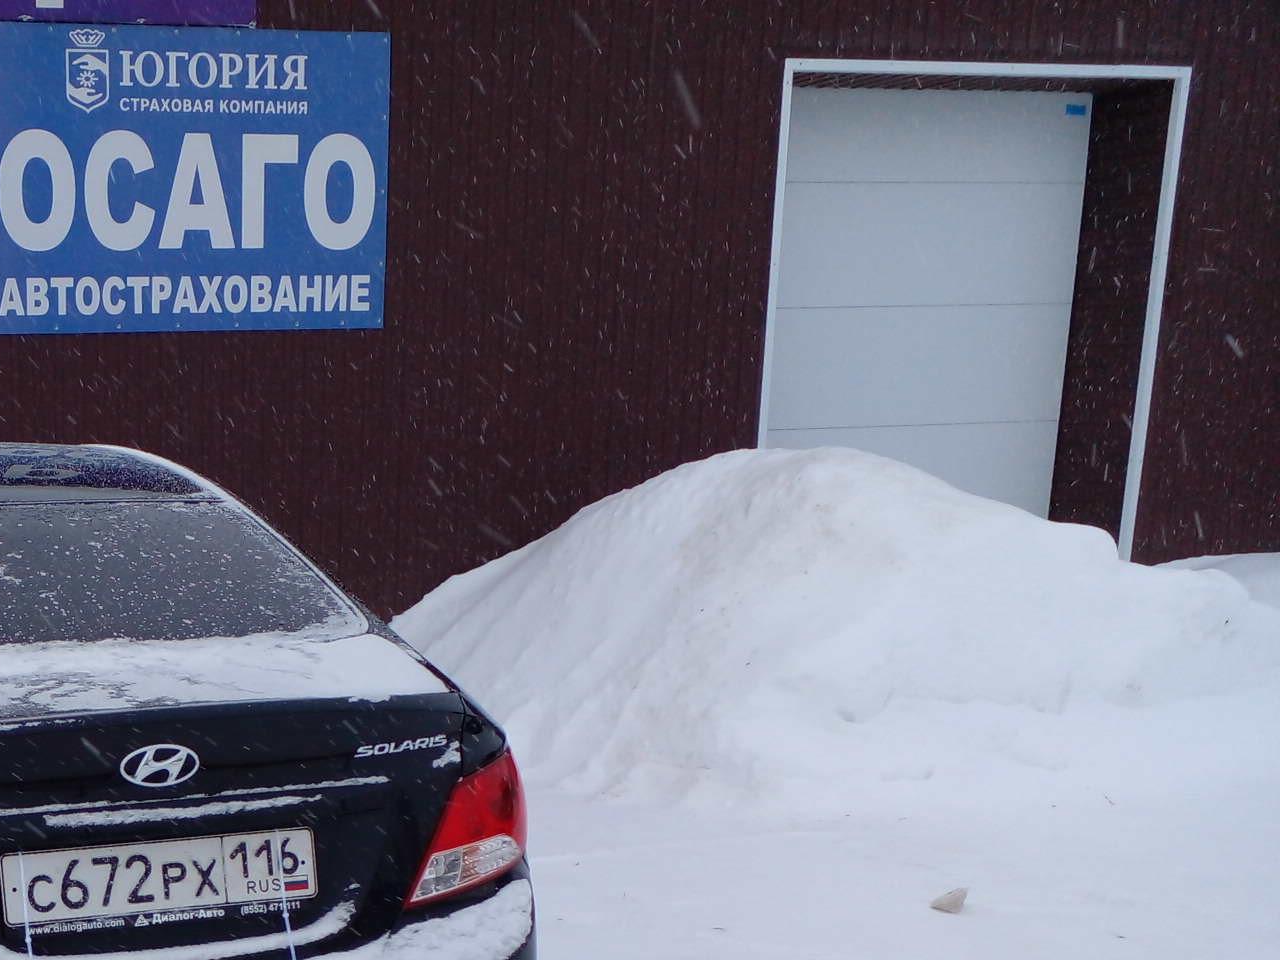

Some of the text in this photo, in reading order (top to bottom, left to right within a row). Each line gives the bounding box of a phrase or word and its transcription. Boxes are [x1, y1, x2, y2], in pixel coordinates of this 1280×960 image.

[119, 50, 308, 90] ЮГОРИЯ
[119, 97, 308, 115] СТРАХОВАЯ КОМПАНИЯ
[354, 734, 448, 758] SOLARIS
[28, 837, 299, 913] С672РХ 116
[246, 878, 282, 895] RUS
[152, 909, 225, 924] Диалог-Авто
[28, 918, 125, 935] www.dialogauto.com
